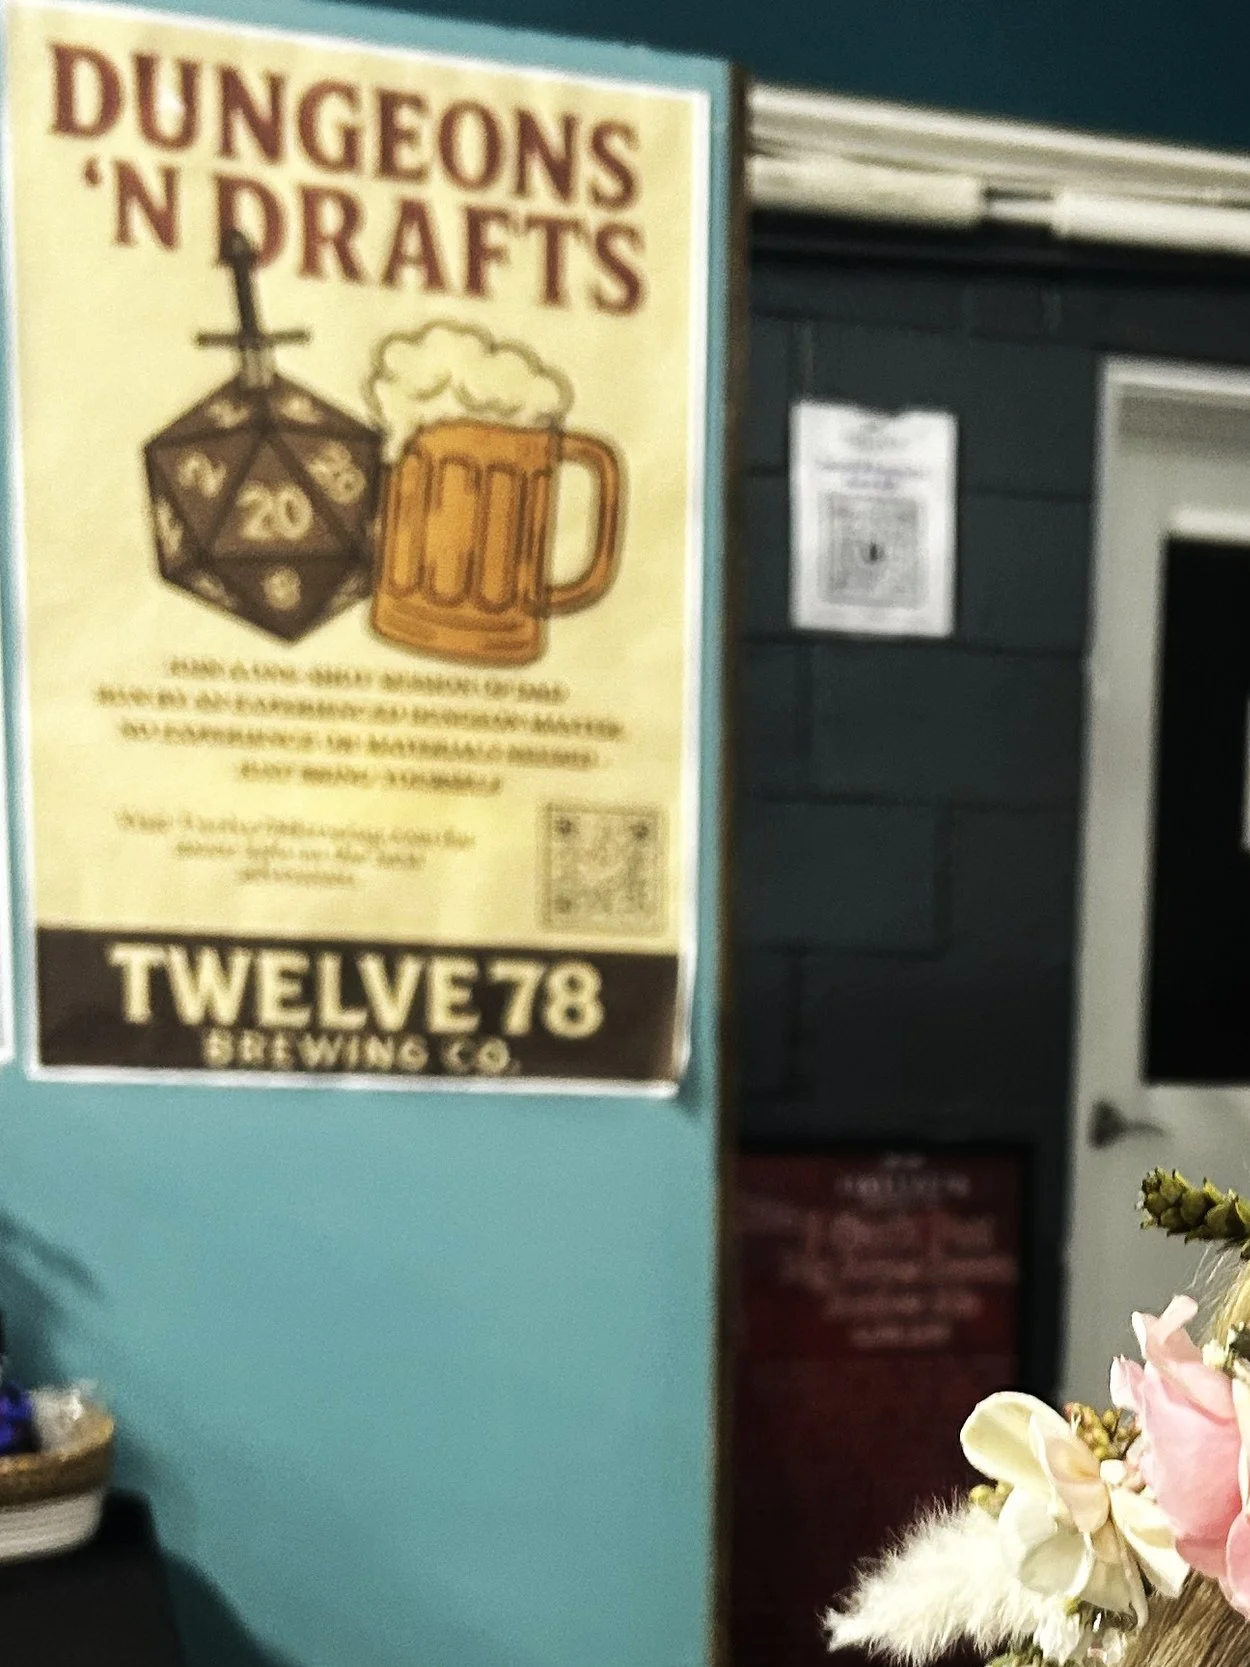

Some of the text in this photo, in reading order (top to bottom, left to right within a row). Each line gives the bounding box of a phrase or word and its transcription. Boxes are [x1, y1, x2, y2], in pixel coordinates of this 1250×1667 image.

[48, 42, 640, 210] DUNGEONS
[212, 173, 647, 316] DRAFTS
[237, 482, 313, 541] 20
[204, 1026, 430, 1072] BREWING
